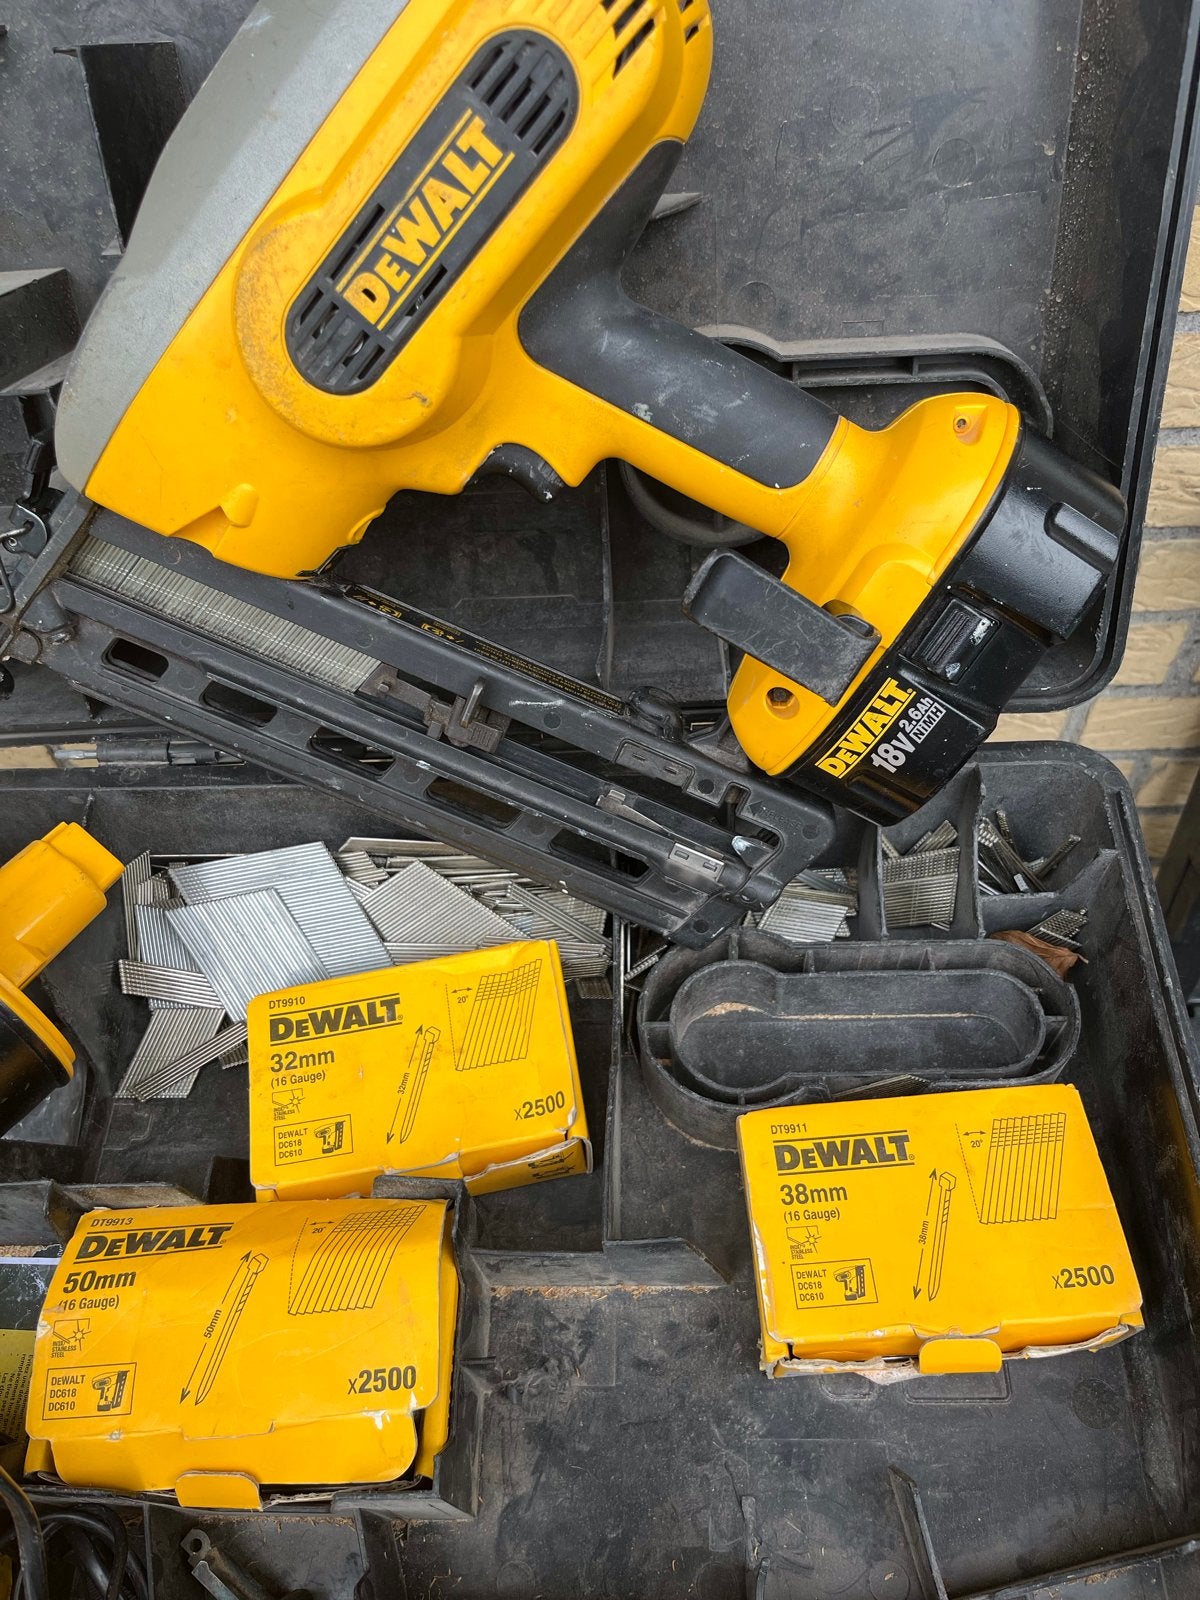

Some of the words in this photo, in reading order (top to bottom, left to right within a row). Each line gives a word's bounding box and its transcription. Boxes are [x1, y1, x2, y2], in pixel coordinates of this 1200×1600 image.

[899, 696, 934, 732] 2.6Ah
[870, 731, 917, 774] 18V
[268, 996, 305, 1009] DT9910
[270, 1050, 335, 1073] 32mm
[271, 1077, 287, 1089] (16
[290, 1070, 326, 1085] Gauge)
[397, 1072, 410, 1095] 32mm
[770, 1123, 808, 1135] DT9911
[278, 1139, 302, 1149] DC618
[970, 1139, 983, 1149] 20°
[279, 1149, 303, 1159] DC610
[779, 1183, 848, 1206] 38mm
[90, 1217, 134, 1228] DT9913
[783, 1211, 801, 1224] (16
[803, 1207, 841, 1222] Gauge)
[918, 1220, 930, 1246] 38mm
[62, 1270, 137, 1294] 50mm
[797, 1281, 823, 1291] DC618
[57, 1300, 76, 1311] (16
[79, 1294, 120, 1309] Gauge)
[799, 1292, 824, 1302] DC610
[203, 1308, 222, 1340] 50mm
[50, 1388, 77, 1399] DC618
[48, 1401, 76, 1412] DC610
